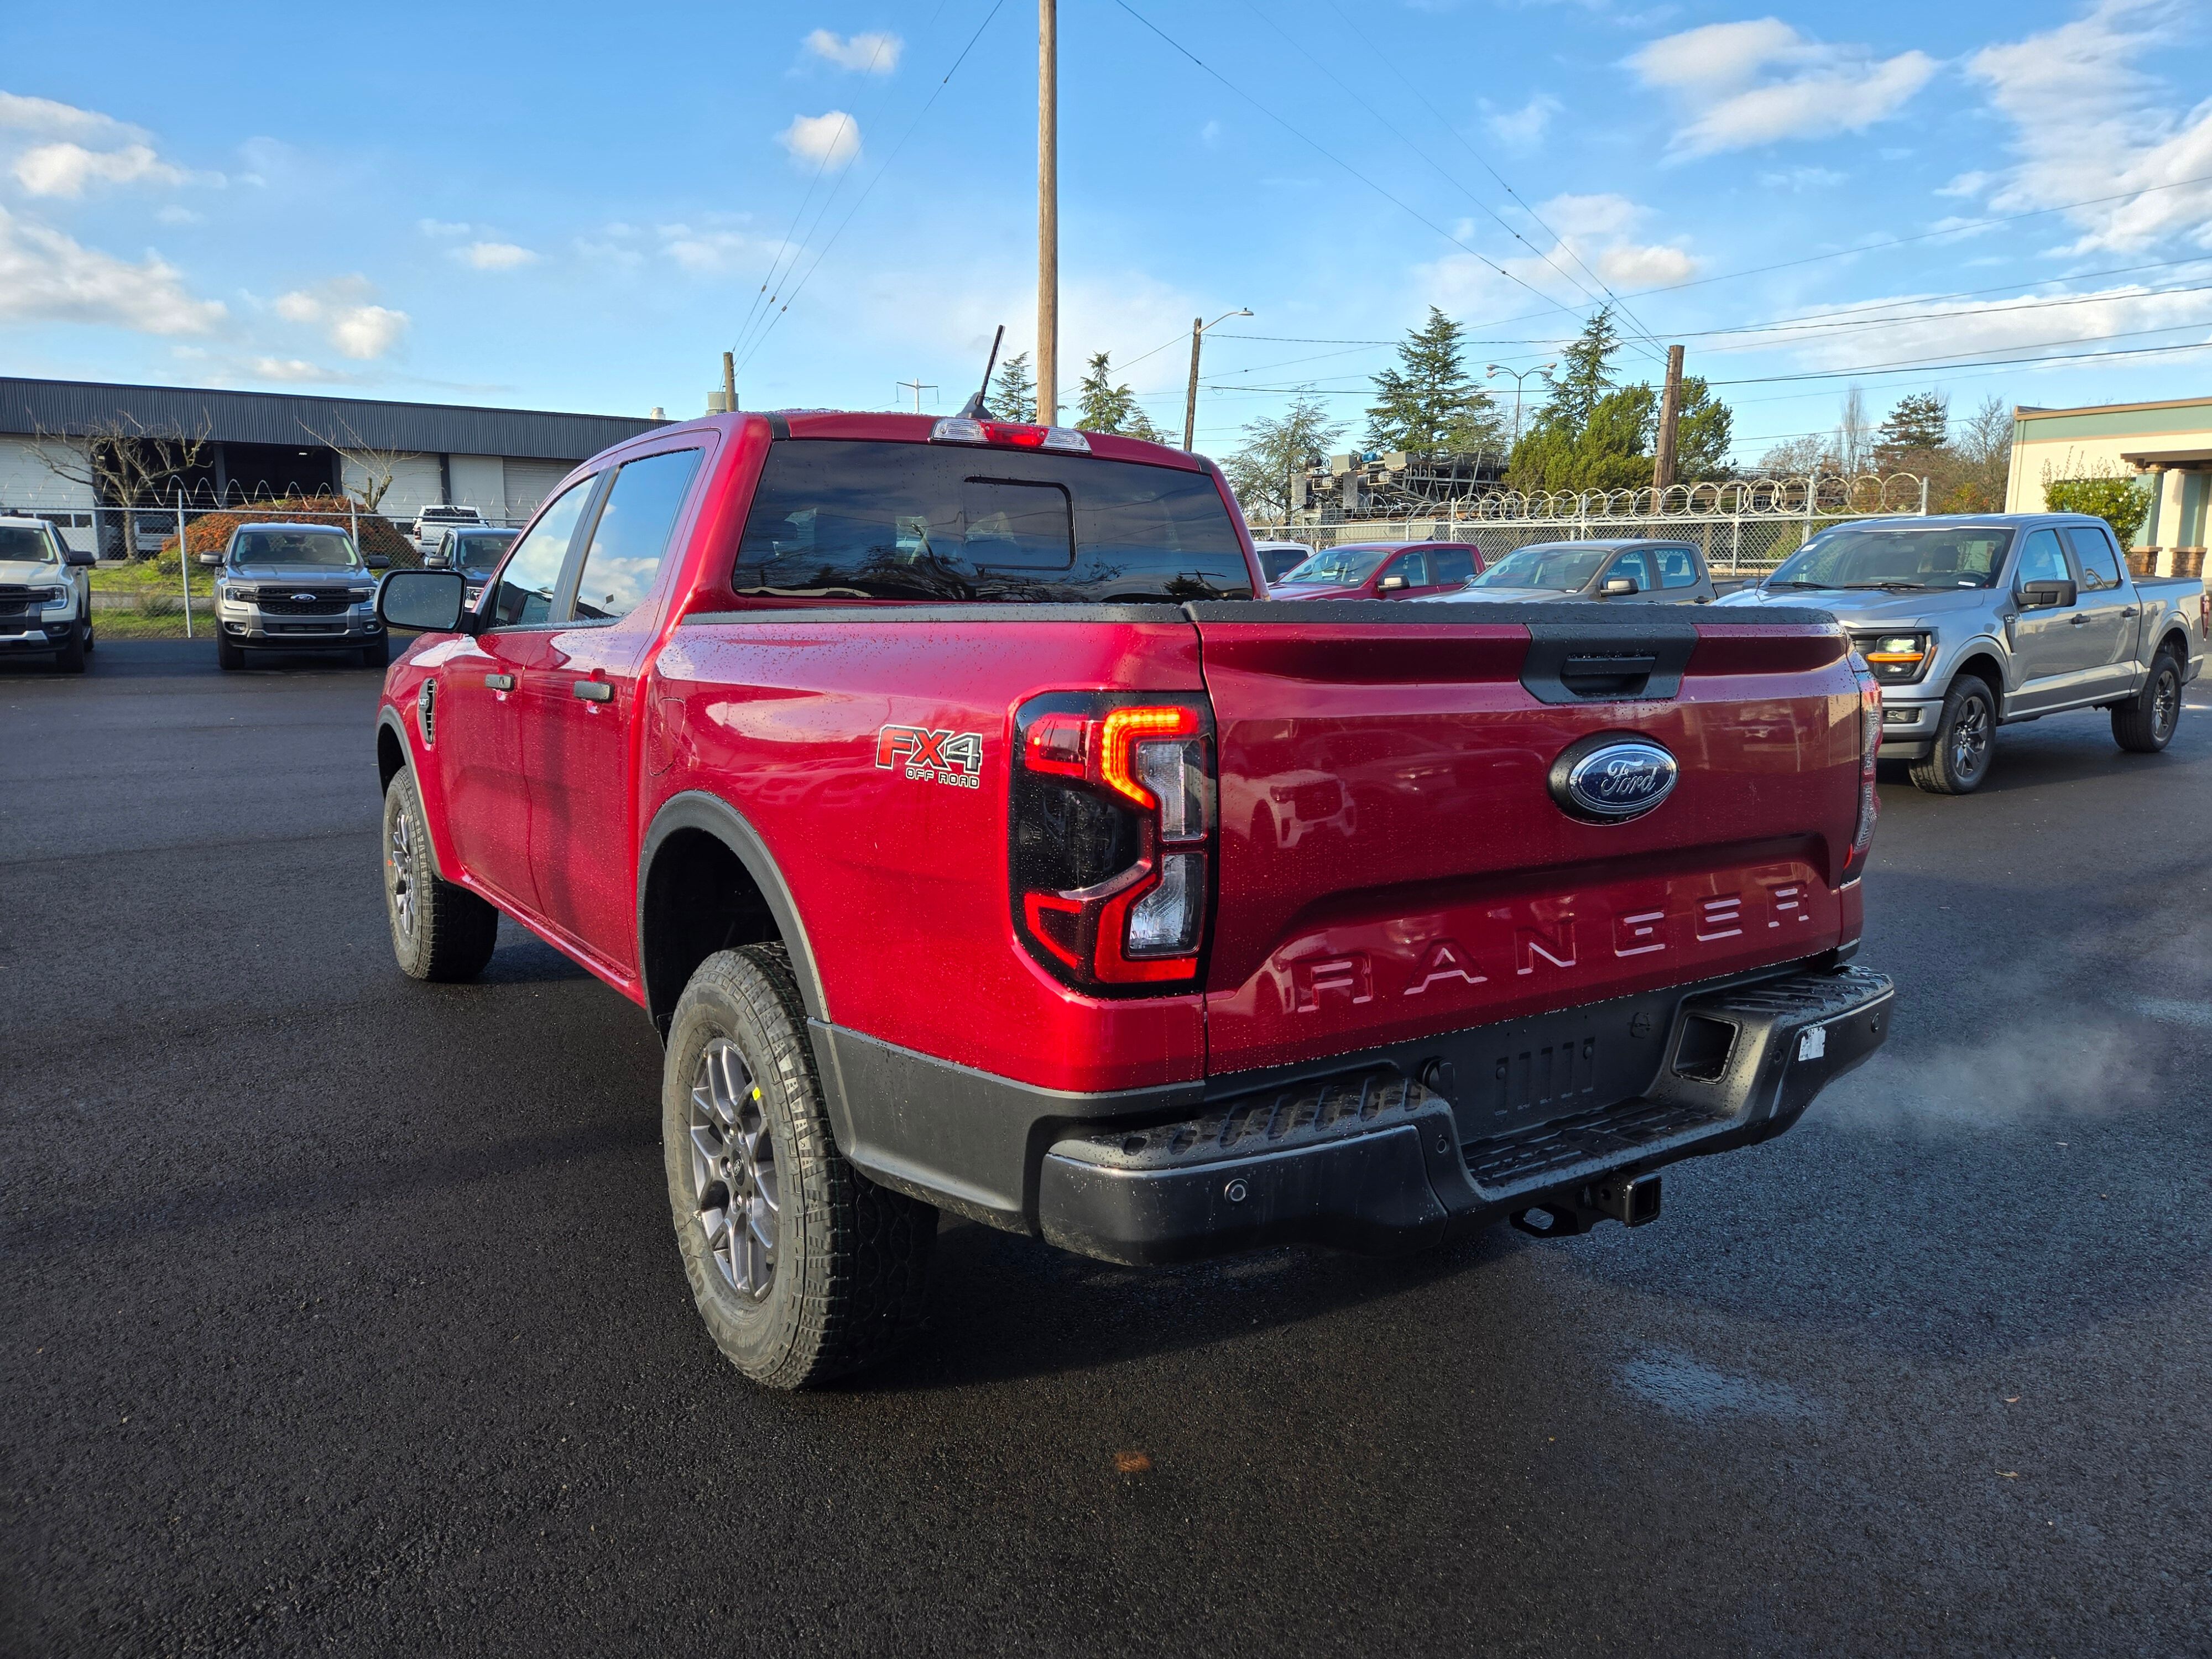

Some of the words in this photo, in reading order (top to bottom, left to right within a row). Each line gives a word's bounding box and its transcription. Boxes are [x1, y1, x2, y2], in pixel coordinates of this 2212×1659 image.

[875, 724, 983, 775] FX4
[905, 768, 935, 781] OFF
[938, 771, 979, 789] ROAD
[1601, 759, 1657, 795] Ford
[1293, 881, 1809, 1013] RANGER
